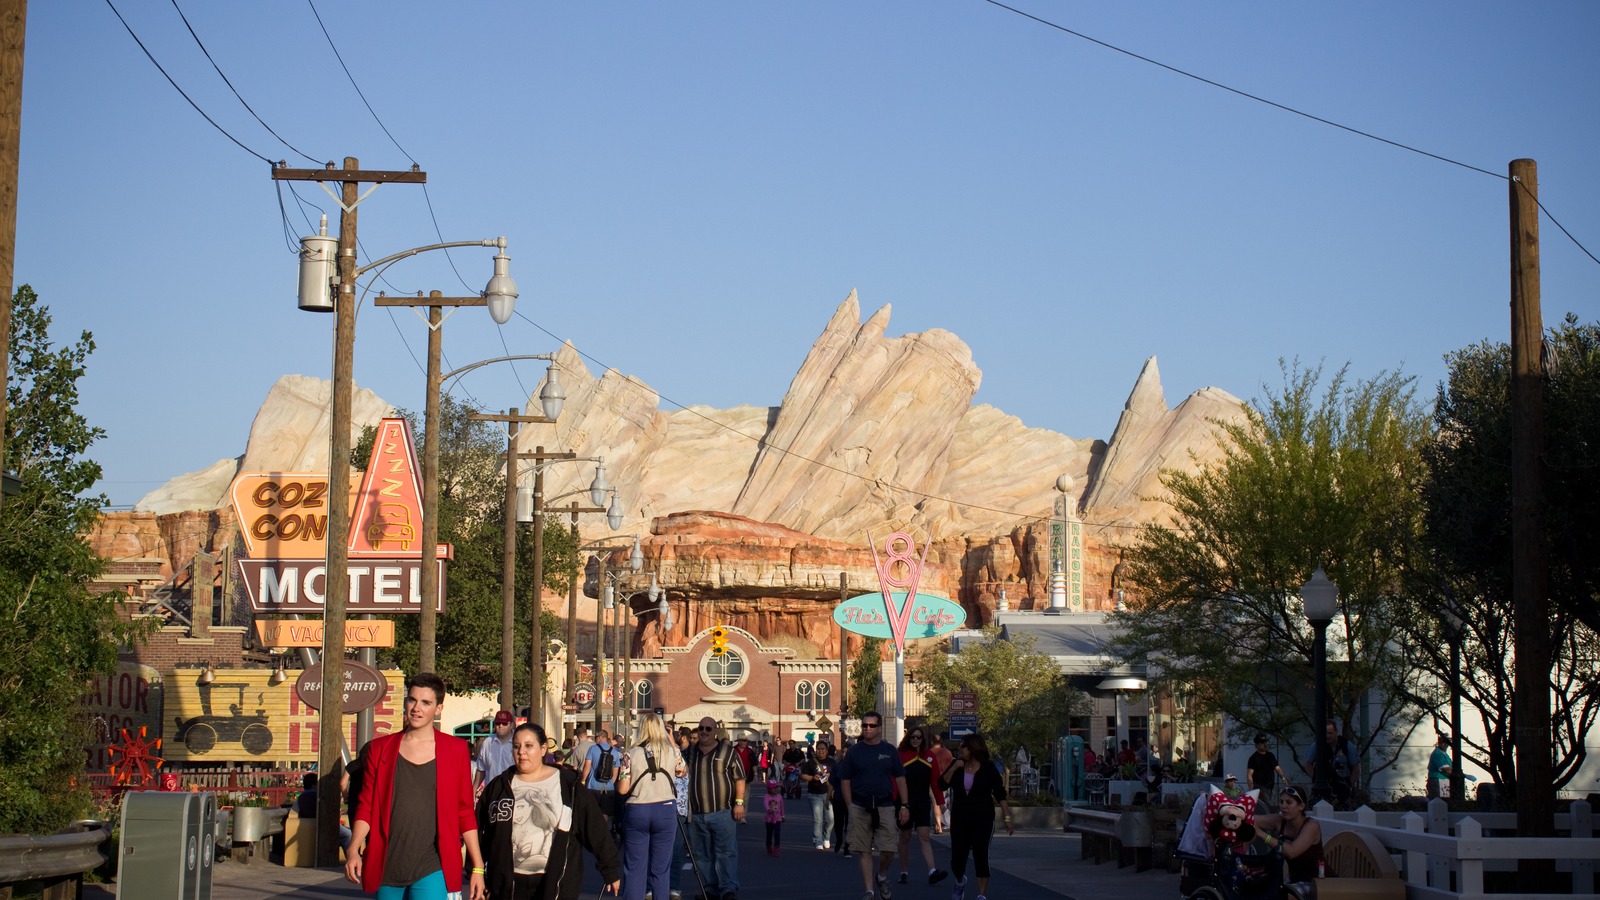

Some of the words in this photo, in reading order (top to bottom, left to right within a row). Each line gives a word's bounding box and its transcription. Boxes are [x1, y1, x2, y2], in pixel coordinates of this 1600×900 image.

[252, 481, 352, 508] COZ
[251, 514, 330, 542] CON
[913, 605, 957, 629] Cafe
[290, 625, 380, 643] VACNCY
